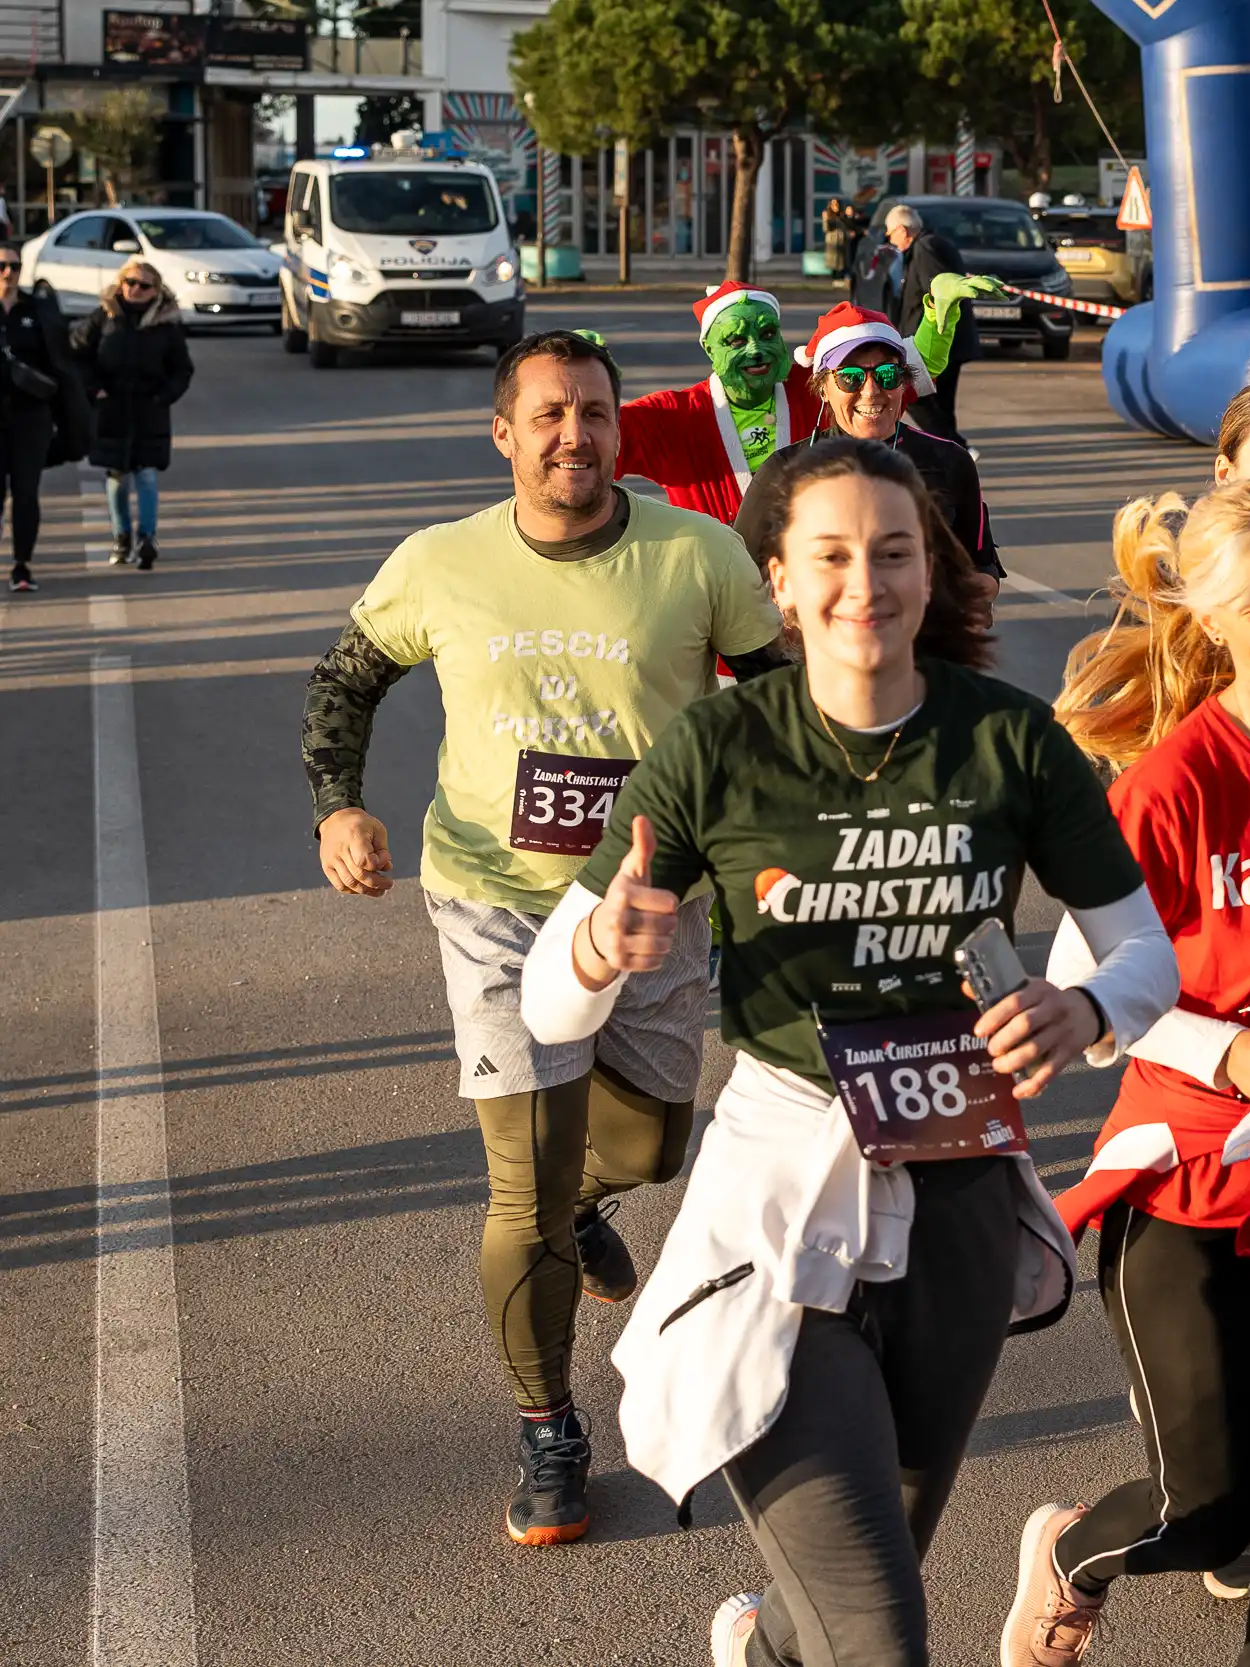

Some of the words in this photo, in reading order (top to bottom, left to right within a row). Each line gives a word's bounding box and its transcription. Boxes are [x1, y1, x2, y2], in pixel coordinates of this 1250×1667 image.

[381, 256, 472, 266] POLICIJA
[488, 630, 629, 664] PESCIA
[540, 675, 577, 700] DI
[533, 768, 564, 783] ZADAR
[565, 771, 620, 787] CHRISTMAS
[528, 787, 614, 828] 334
[832, 824, 973, 871] ZADAR
[768, 866, 1006, 923] CHRISTMAS
[853, 924, 951, 967] RUN
[846, 1048, 885, 1066] ZADAR
[885, 1039, 957, 1061] CHRISTMAS
[959, 1033, 989, 1051] RUN
[855, 1062, 967, 1122] 188
